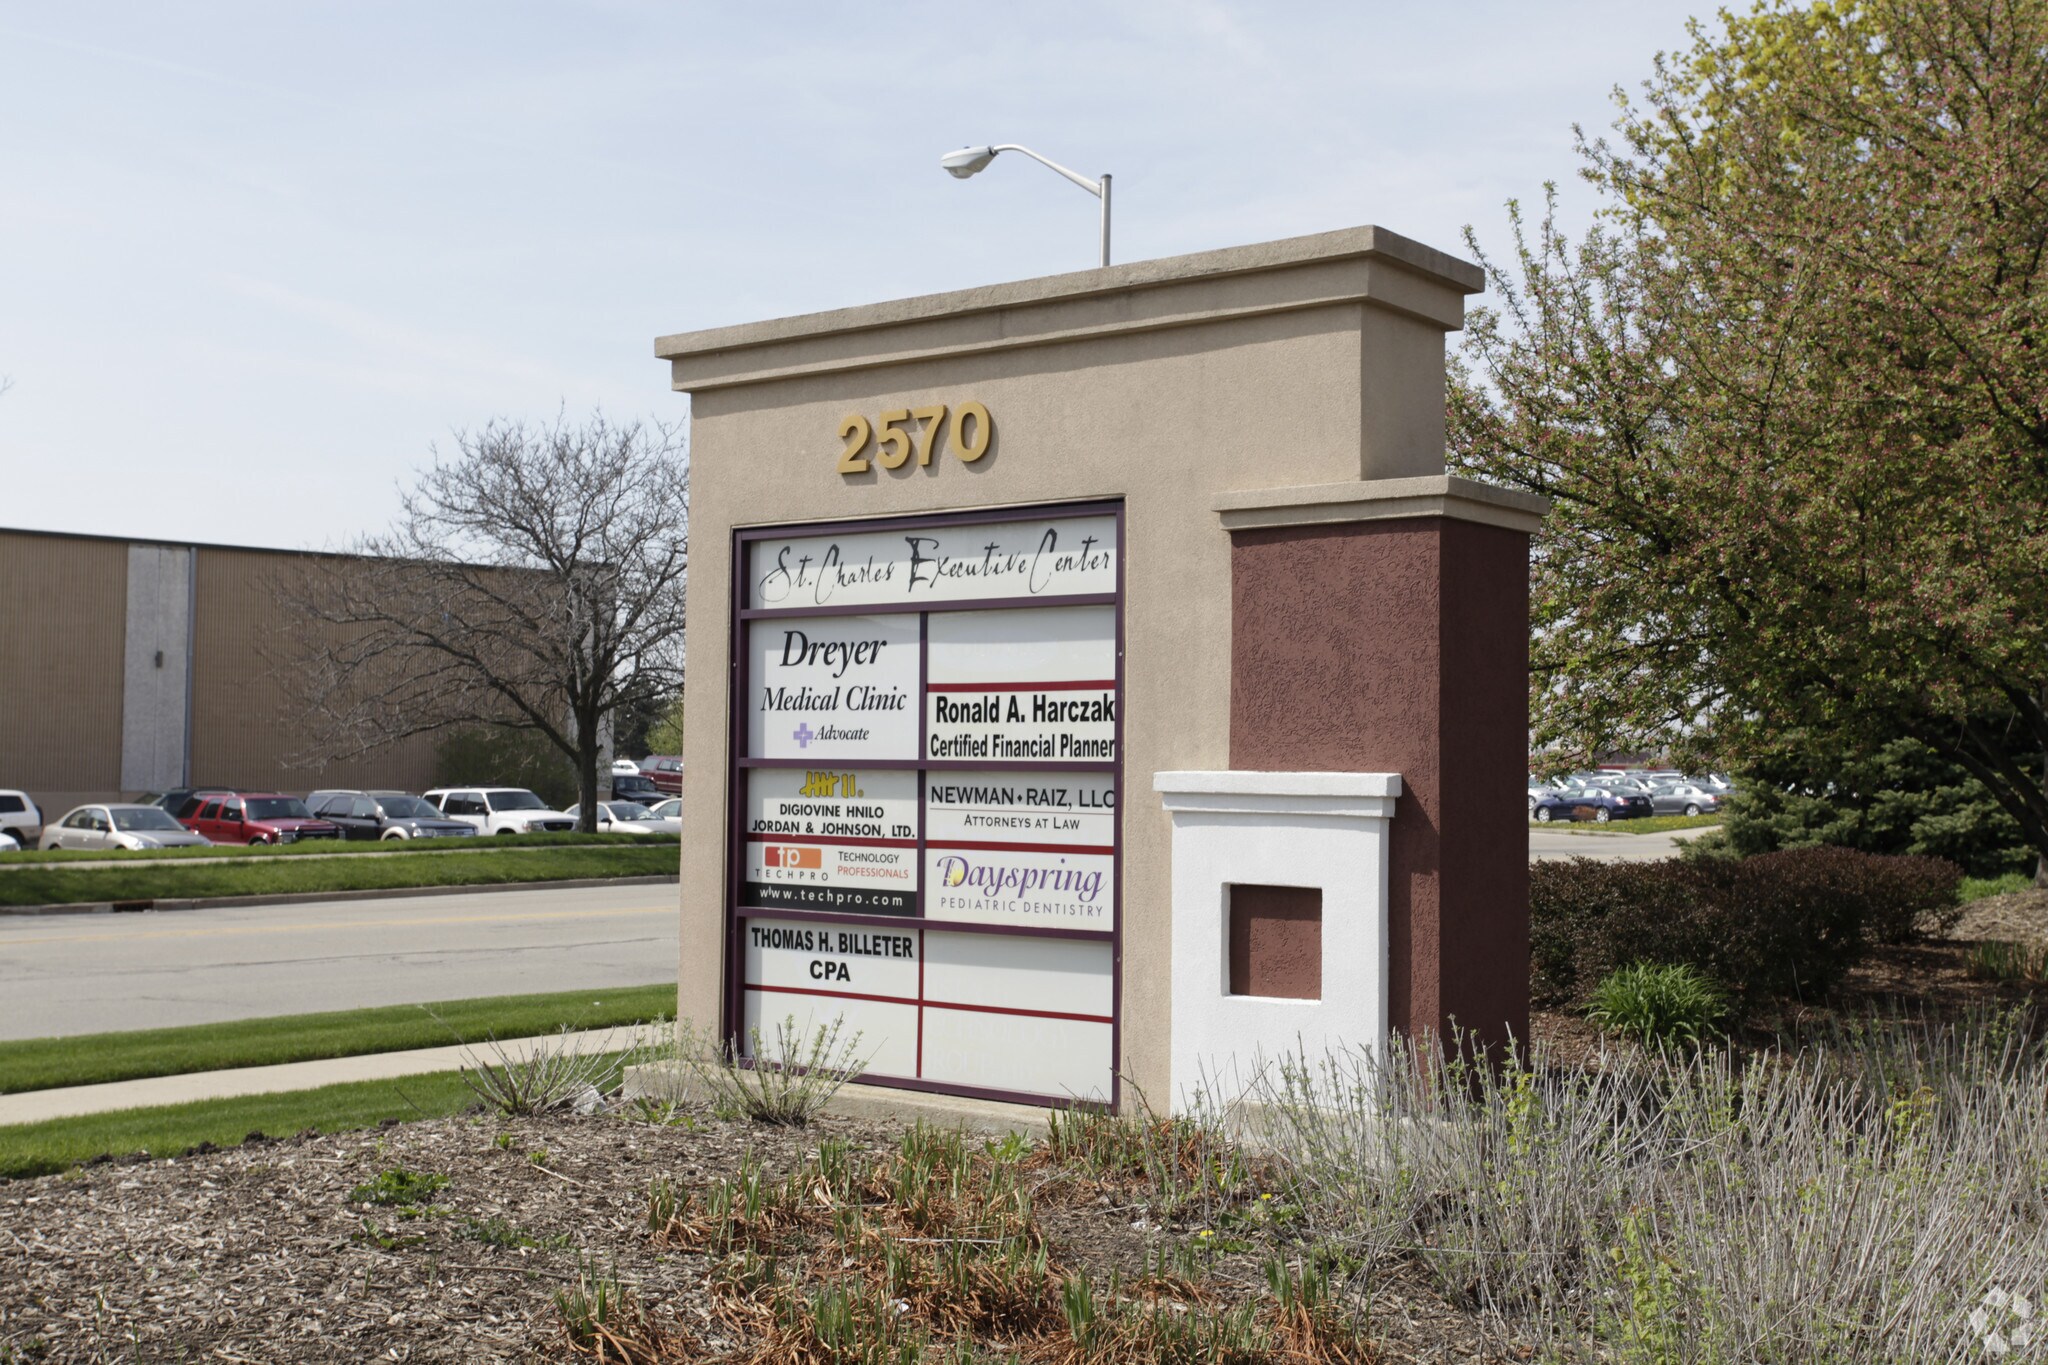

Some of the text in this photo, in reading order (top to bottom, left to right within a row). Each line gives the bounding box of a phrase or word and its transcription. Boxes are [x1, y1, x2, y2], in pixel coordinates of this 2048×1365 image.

[836, 400, 992, 474] 2570
[758, 528, 1110, 605] St. Charles Executive Center
[779, 630, 888, 678] Dreyer
[760, 685, 907, 712] Medical Clinic
[935, 693, 1115, 723] Ronald A. Harczak
[814, 724, 870, 742] Advocate
[930, 733, 1115, 758] Certified Financial Planner
[931, 786, 1115, 811] NEWMAN RAIZ, LLC
[779, 803, 884, 818] DIGIOVINE HNILO
[752, 820, 916, 838] JORDAN & JOHNSON, LTD.
[964, 814, 1080, 830] ATTORNEYS AT LAW
[838, 851, 899, 864] TECHNOLOGY
[755, 868, 829, 881] TECHPRO
[837, 865, 909, 879] PROFESSIONALS
[936, 855, 1107, 903] Dayspring
[759, 886, 903, 906] www.techpro.com
[940, 896, 1104, 917] PEDIATRIC DENTISTRY
[751, 927, 913, 958] THOMAS H. BILLETER
[809, 960, 851, 982] CPA
